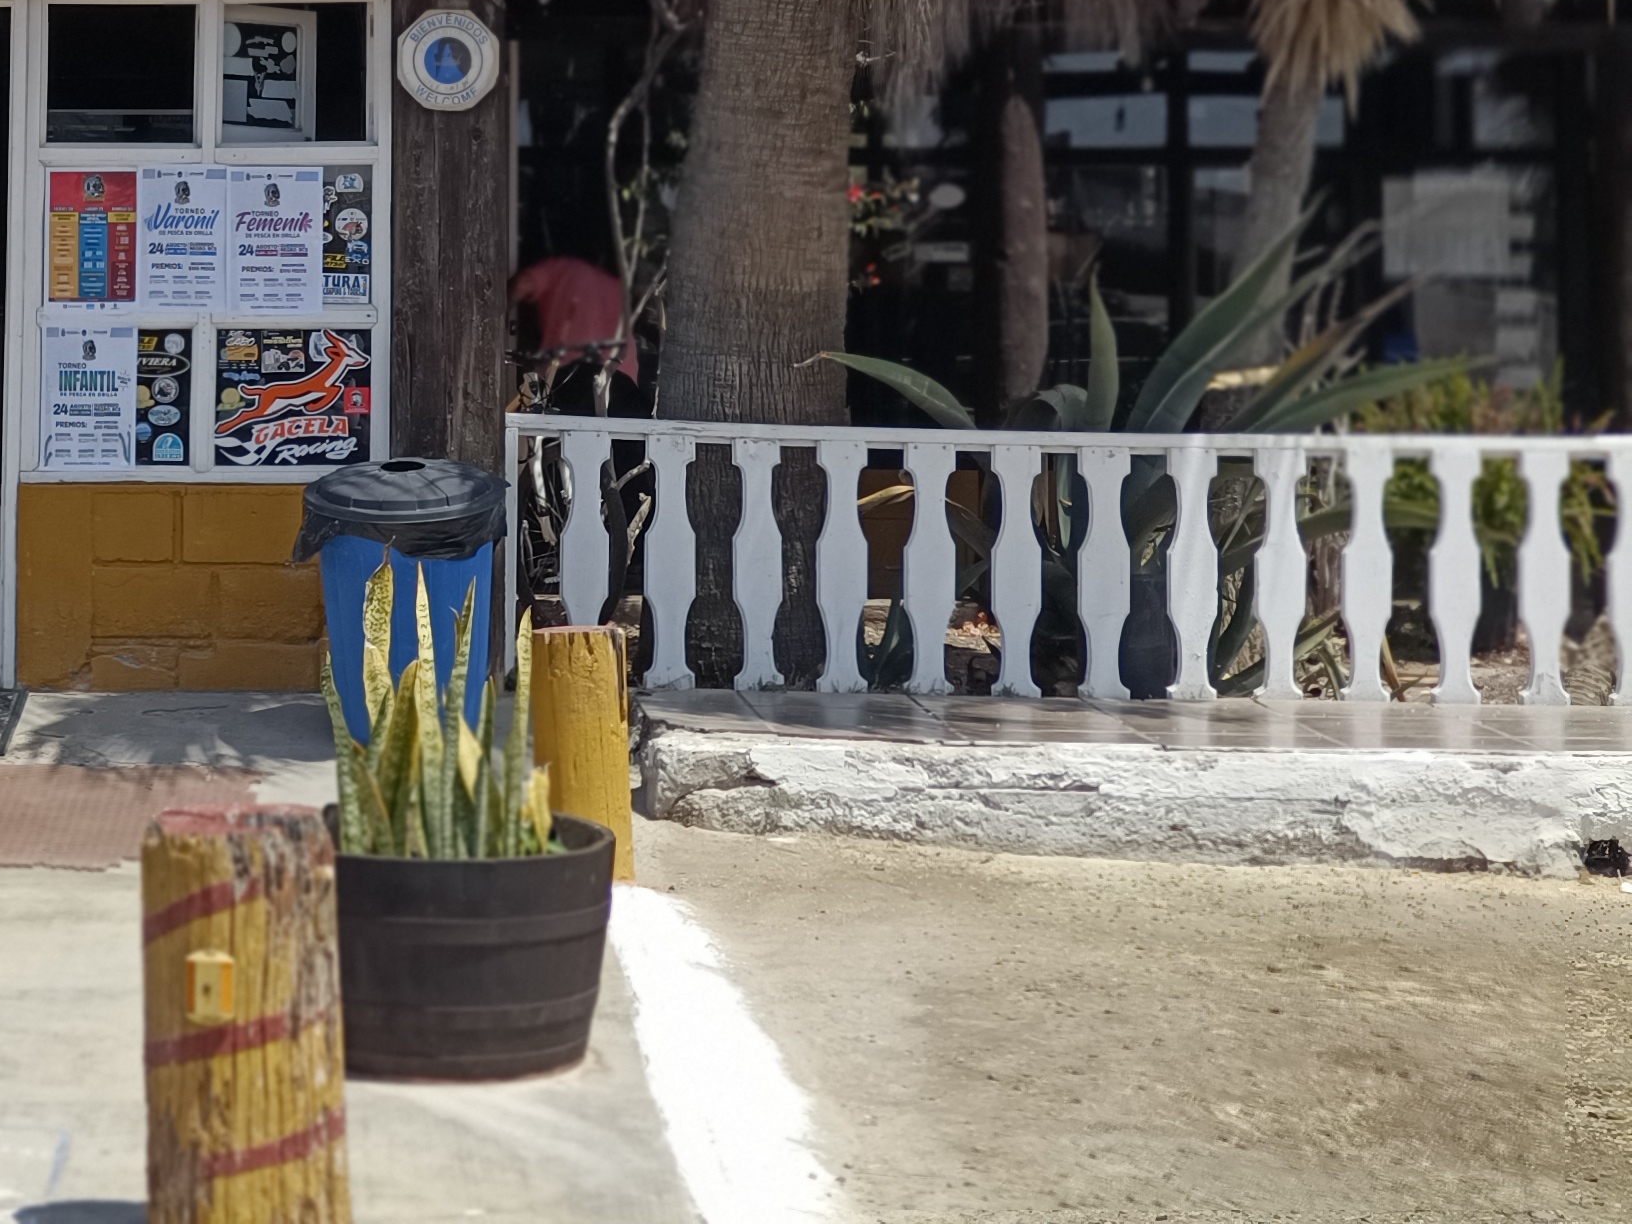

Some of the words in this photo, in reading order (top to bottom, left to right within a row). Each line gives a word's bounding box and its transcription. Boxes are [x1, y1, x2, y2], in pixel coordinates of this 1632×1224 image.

[409, 14, 489, 46] BIENVENIDOS
[152, 202, 220, 230] Varonil
[148, 242, 164, 254] 24
[238, 244, 254, 256] 24
[58, 370, 119, 392] INFANTIL
[53, 403, 68, 416] 24
[253, 416, 348, 445] GACELA
[274, 437, 358, 465] Racing
